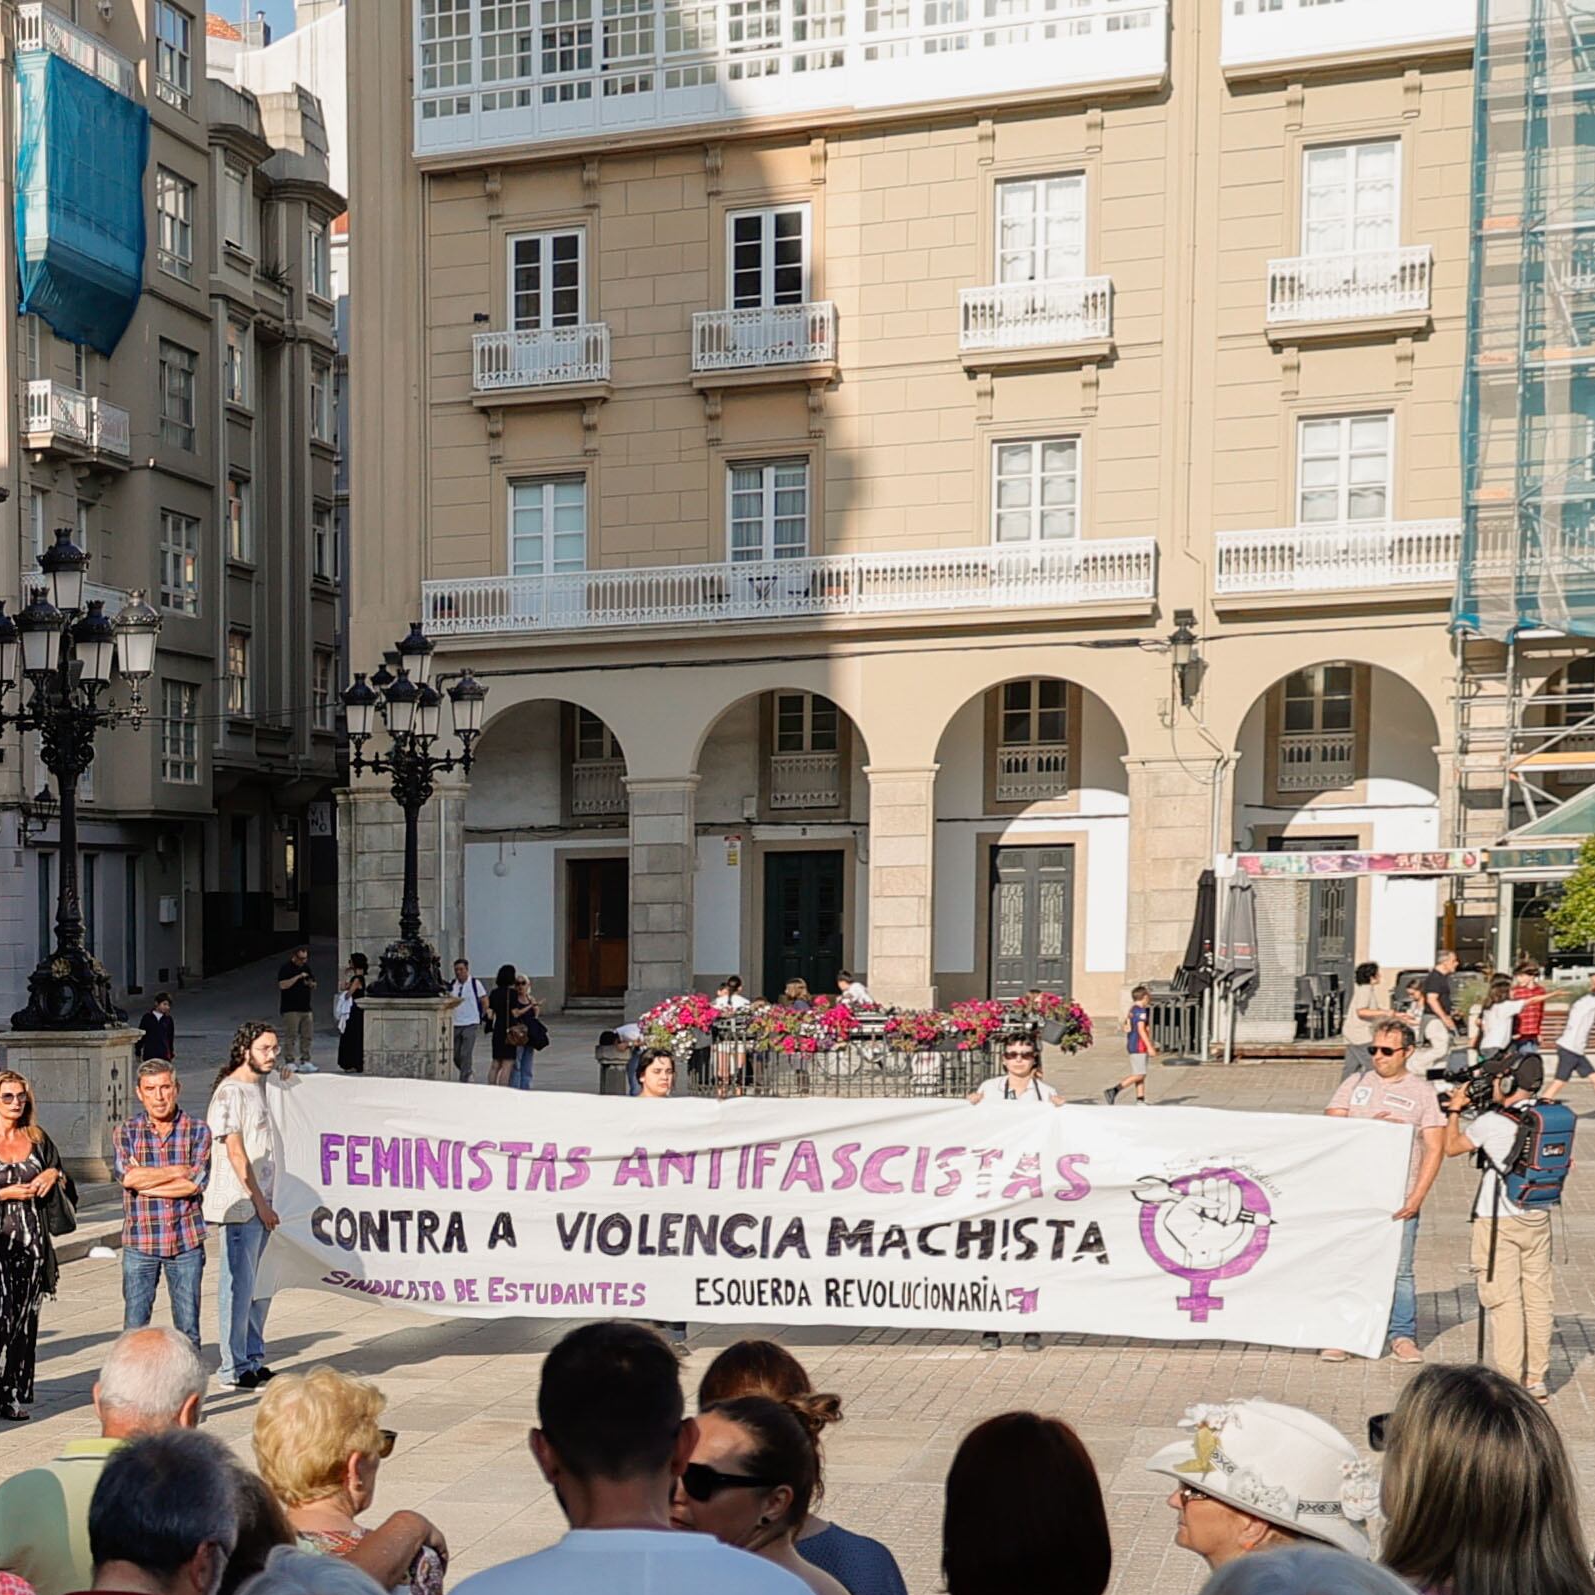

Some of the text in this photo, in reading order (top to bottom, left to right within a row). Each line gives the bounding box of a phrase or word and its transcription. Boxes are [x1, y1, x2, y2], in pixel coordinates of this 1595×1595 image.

[320, 1133, 593, 1191] FEMINISTAS
[613, 1140, 1091, 1201] ANTIFASCISTAS
[311, 1205, 1111, 1265] CONTRA A VIOLENCIA MACHISTA
[321, 1270, 646, 1307] SINDICATO DE ESTUDANTES
[695, 1277, 812, 1307] ESQUERDA
